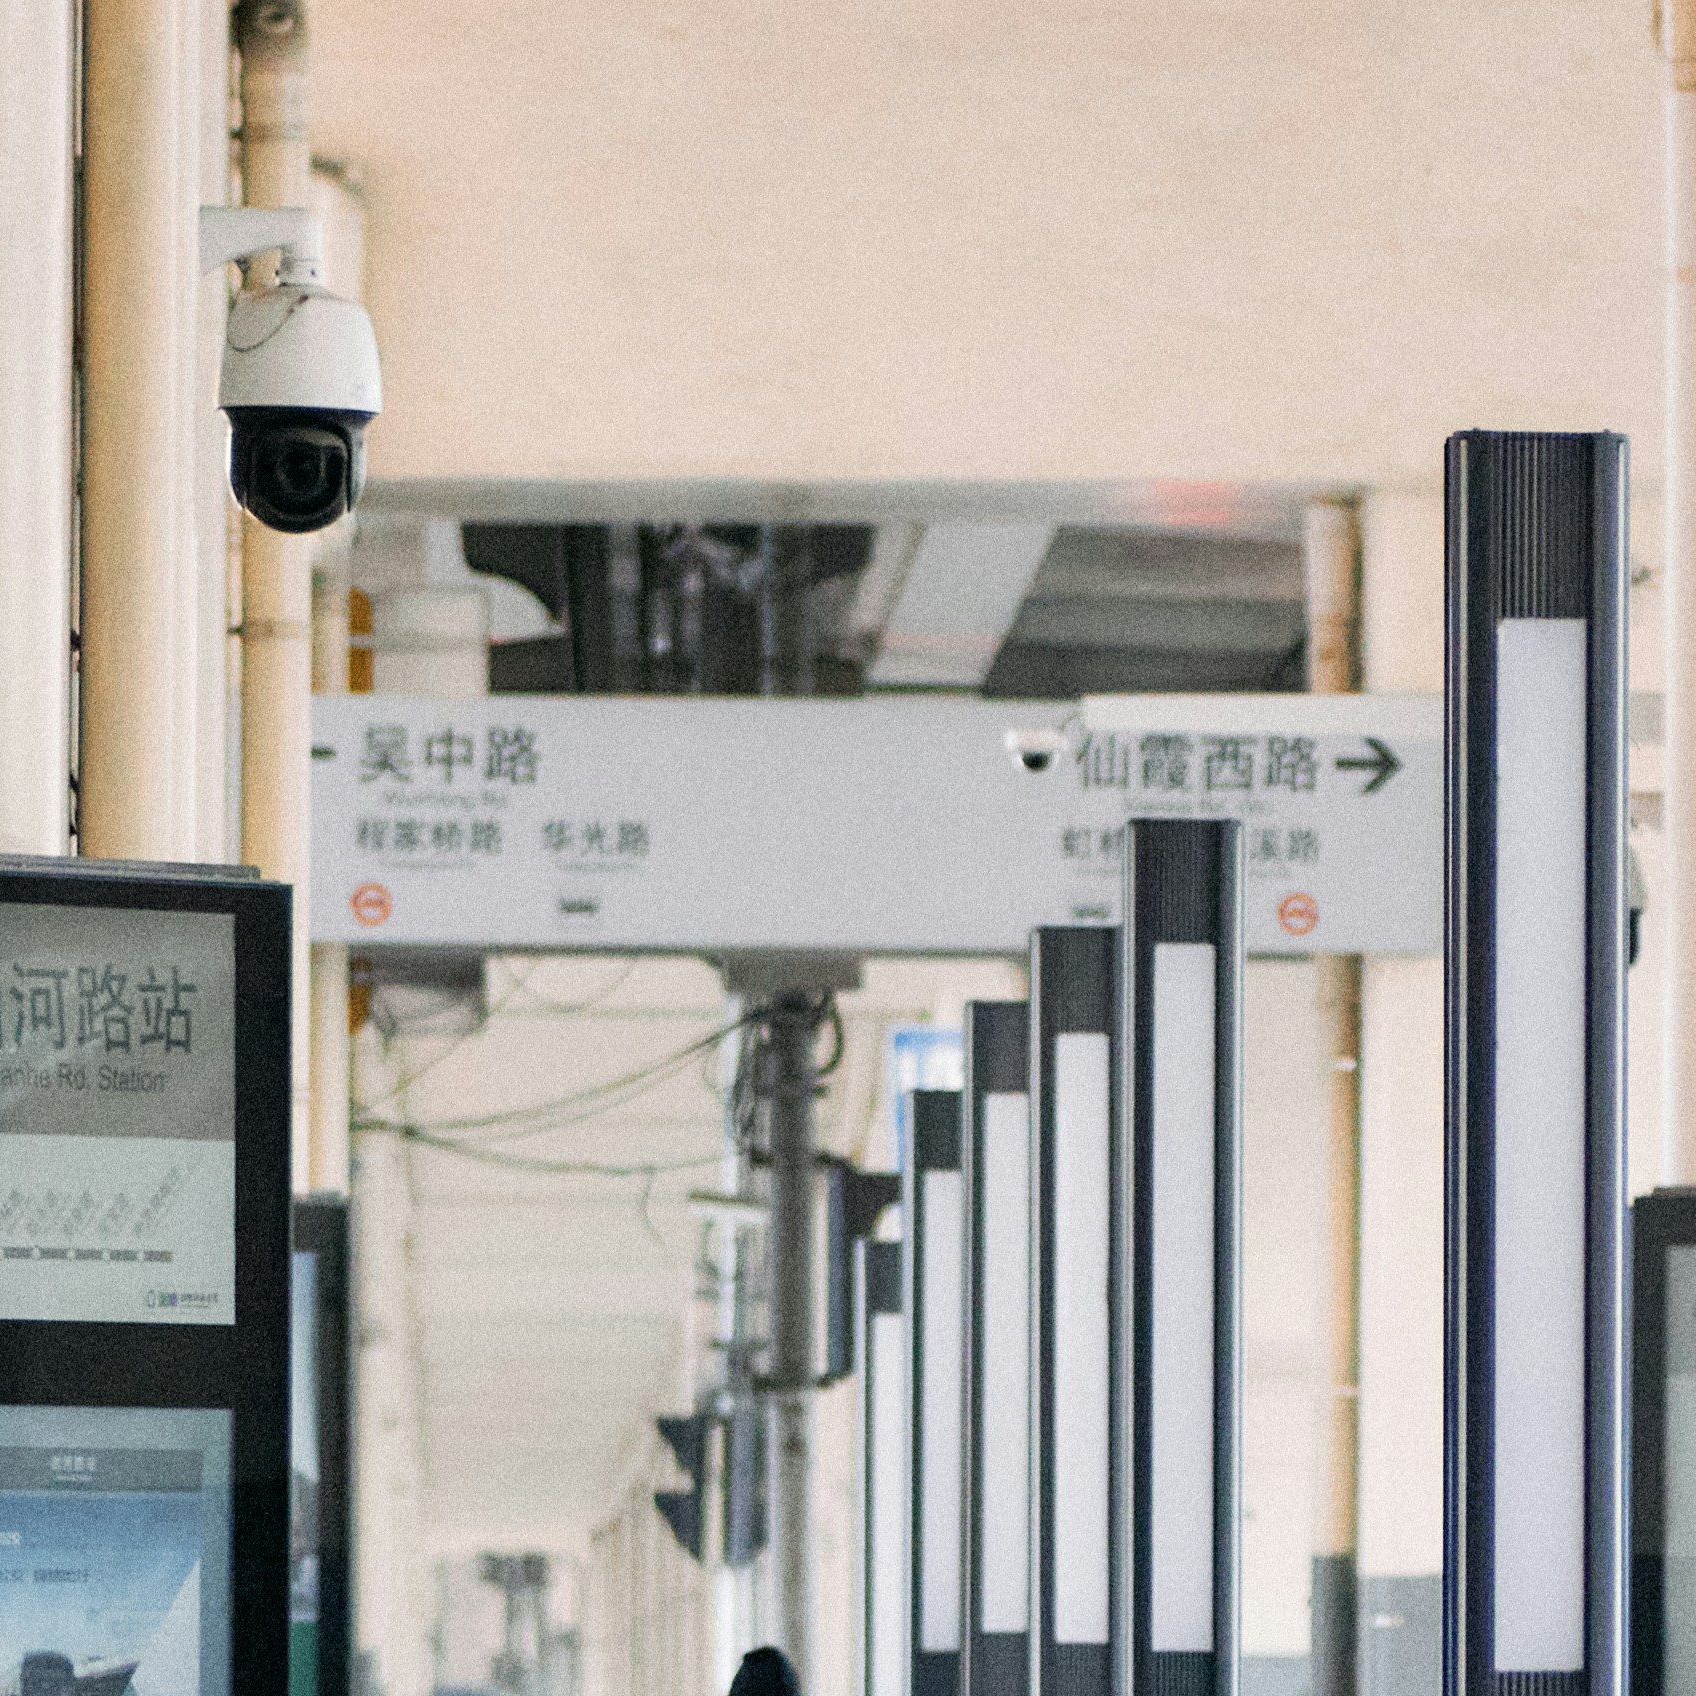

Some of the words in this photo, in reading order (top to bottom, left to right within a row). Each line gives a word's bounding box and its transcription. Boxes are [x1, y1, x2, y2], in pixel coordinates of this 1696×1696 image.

[358, 725, 540, 785] 吴中路
[1076, 732, 1317, 791] 仙霞西路
[57, 1063, 87, 1091] Rd.
[96, 1066, 167, 1094] Station
